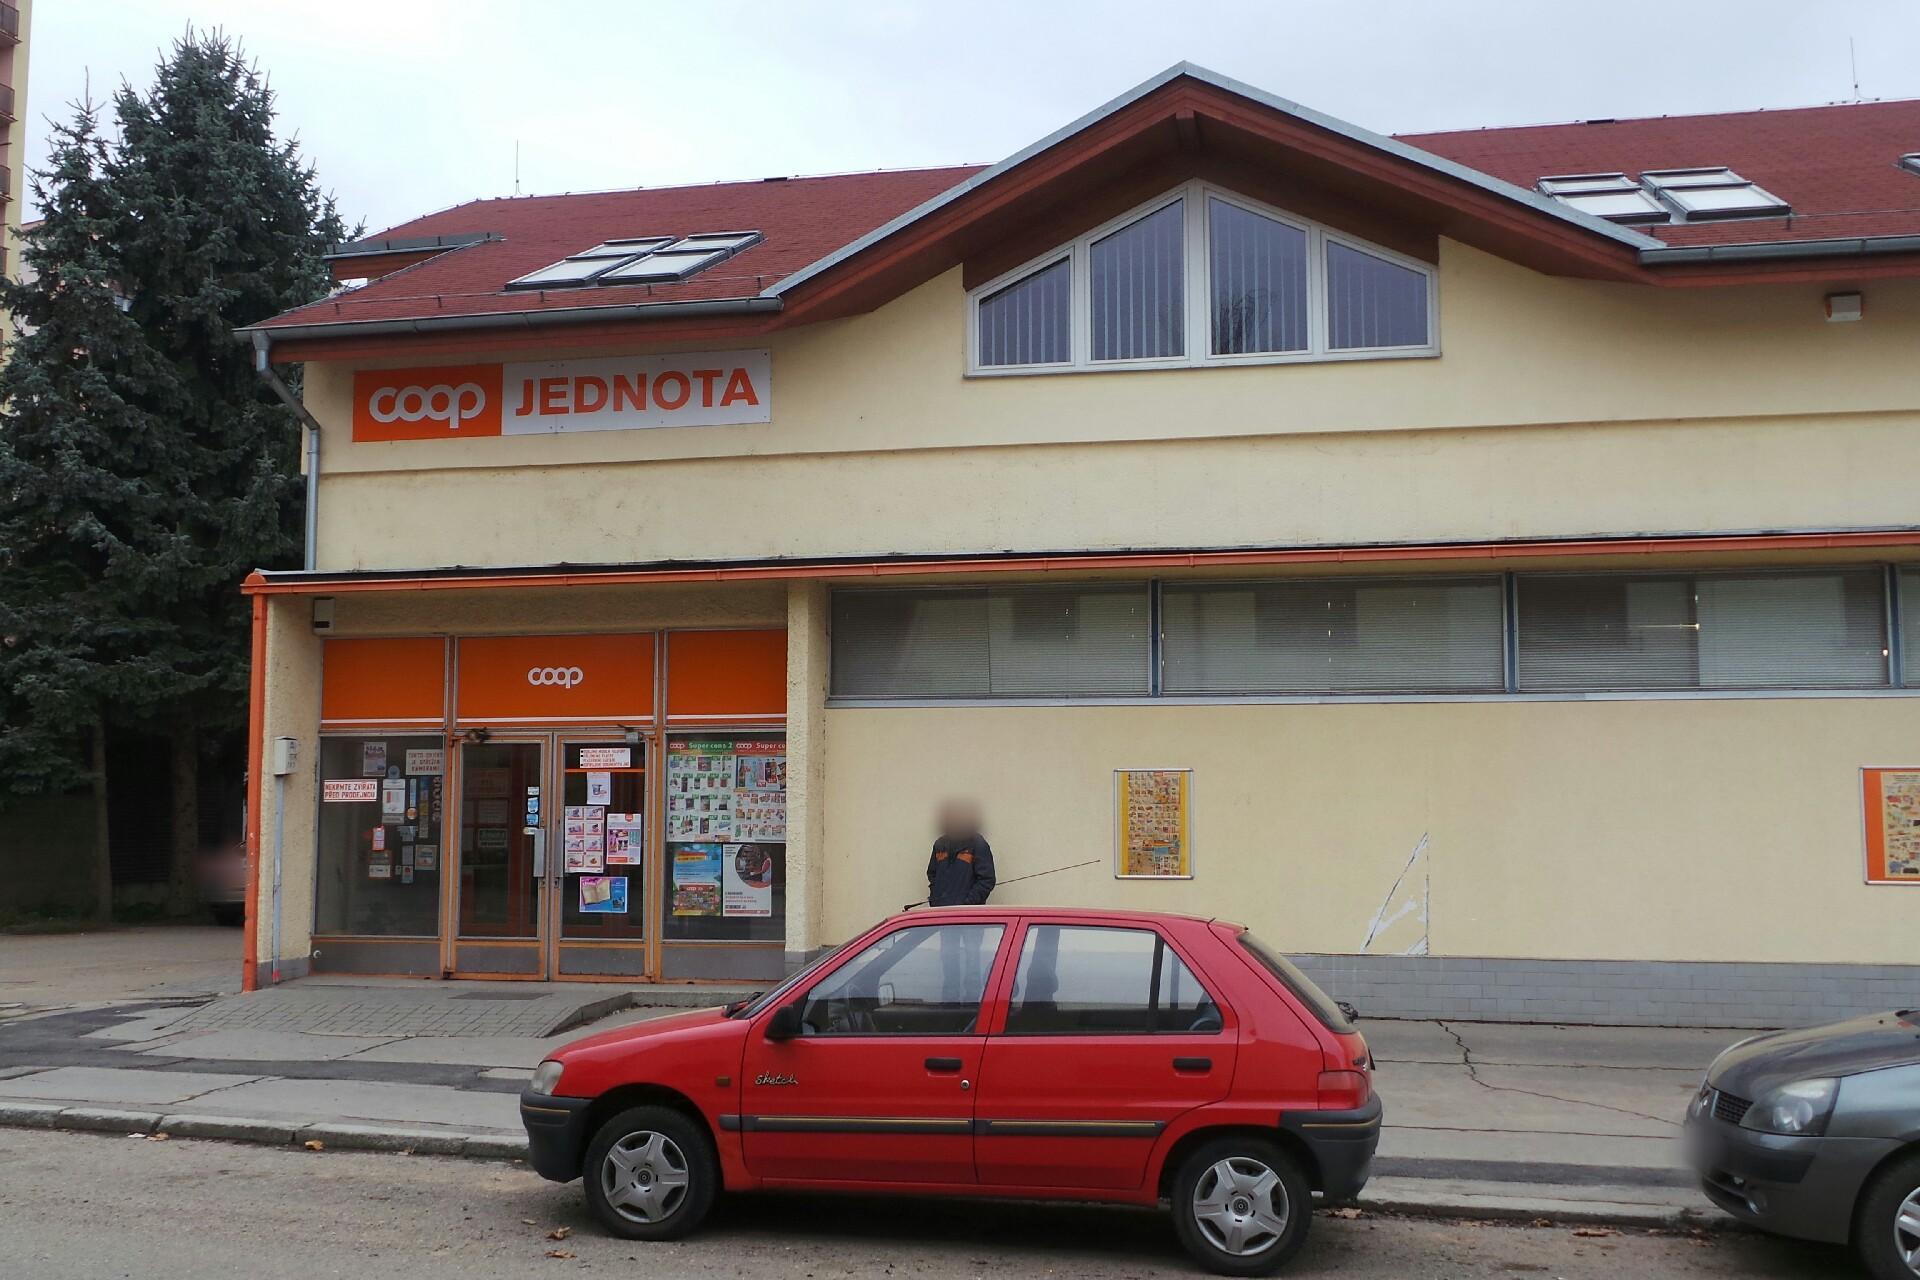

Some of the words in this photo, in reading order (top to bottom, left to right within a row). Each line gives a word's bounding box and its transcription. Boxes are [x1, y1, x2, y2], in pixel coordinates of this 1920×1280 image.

[368, 382, 486, 429] coop
[515, 367, 760, 417] JEDNOTA
[527, 666, 584, 689] coop
[688, 742, 709, 750] Super
[756, 742, 776, 750] Super
